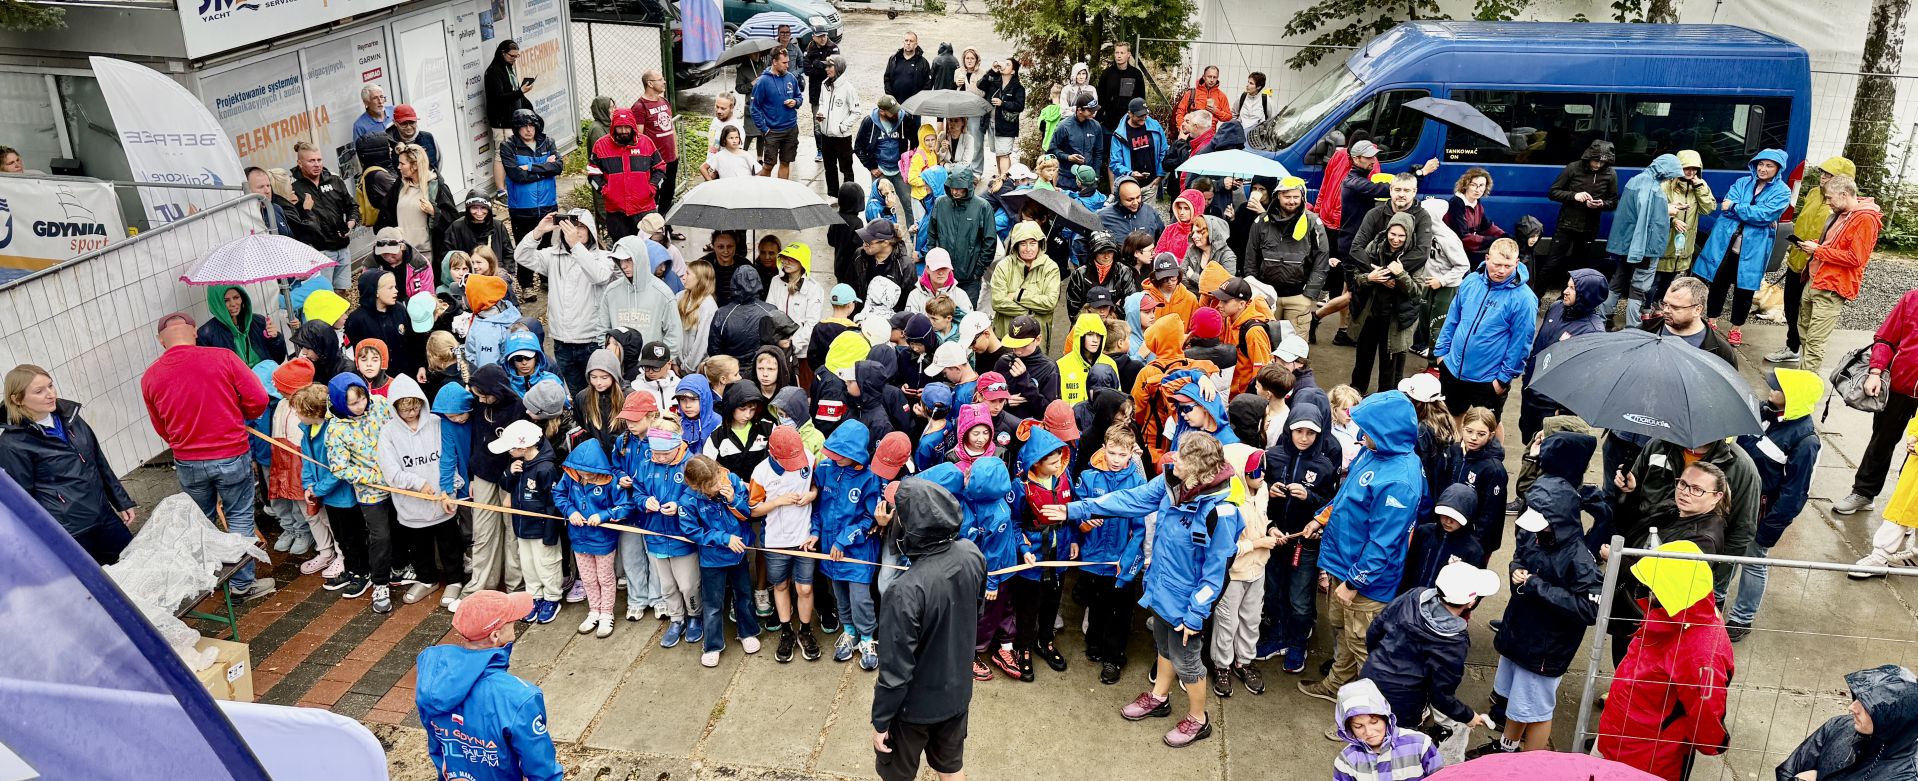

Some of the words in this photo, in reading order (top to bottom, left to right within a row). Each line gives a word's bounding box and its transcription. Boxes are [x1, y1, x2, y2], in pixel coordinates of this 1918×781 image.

[202, 11, 232, 22] YACHT
[358, 53, 382, 65] GARMIN
[216, 85, 266, 109] Projektowanie
[267, 74, 300, 93] systemów
[218, 95, 278, 120] komunikacyjnych
[283, 85, 301, 98] audio
[236, 104, 330, 158] ELEKTRONIKA
[1132, 135, 1149, 148] HH
[1445, 147, 1478, 155] TANKOWAĆ
[320, 184, 333, 193] HH
[33, 220, 107, 237] GDYNIA
[70, 235, 109, 254] sport
[1062, 489, 1071, 498] HH
[452, 729, 498, 750] GDYNIA
[463, 751, 500, 768] TEAM
